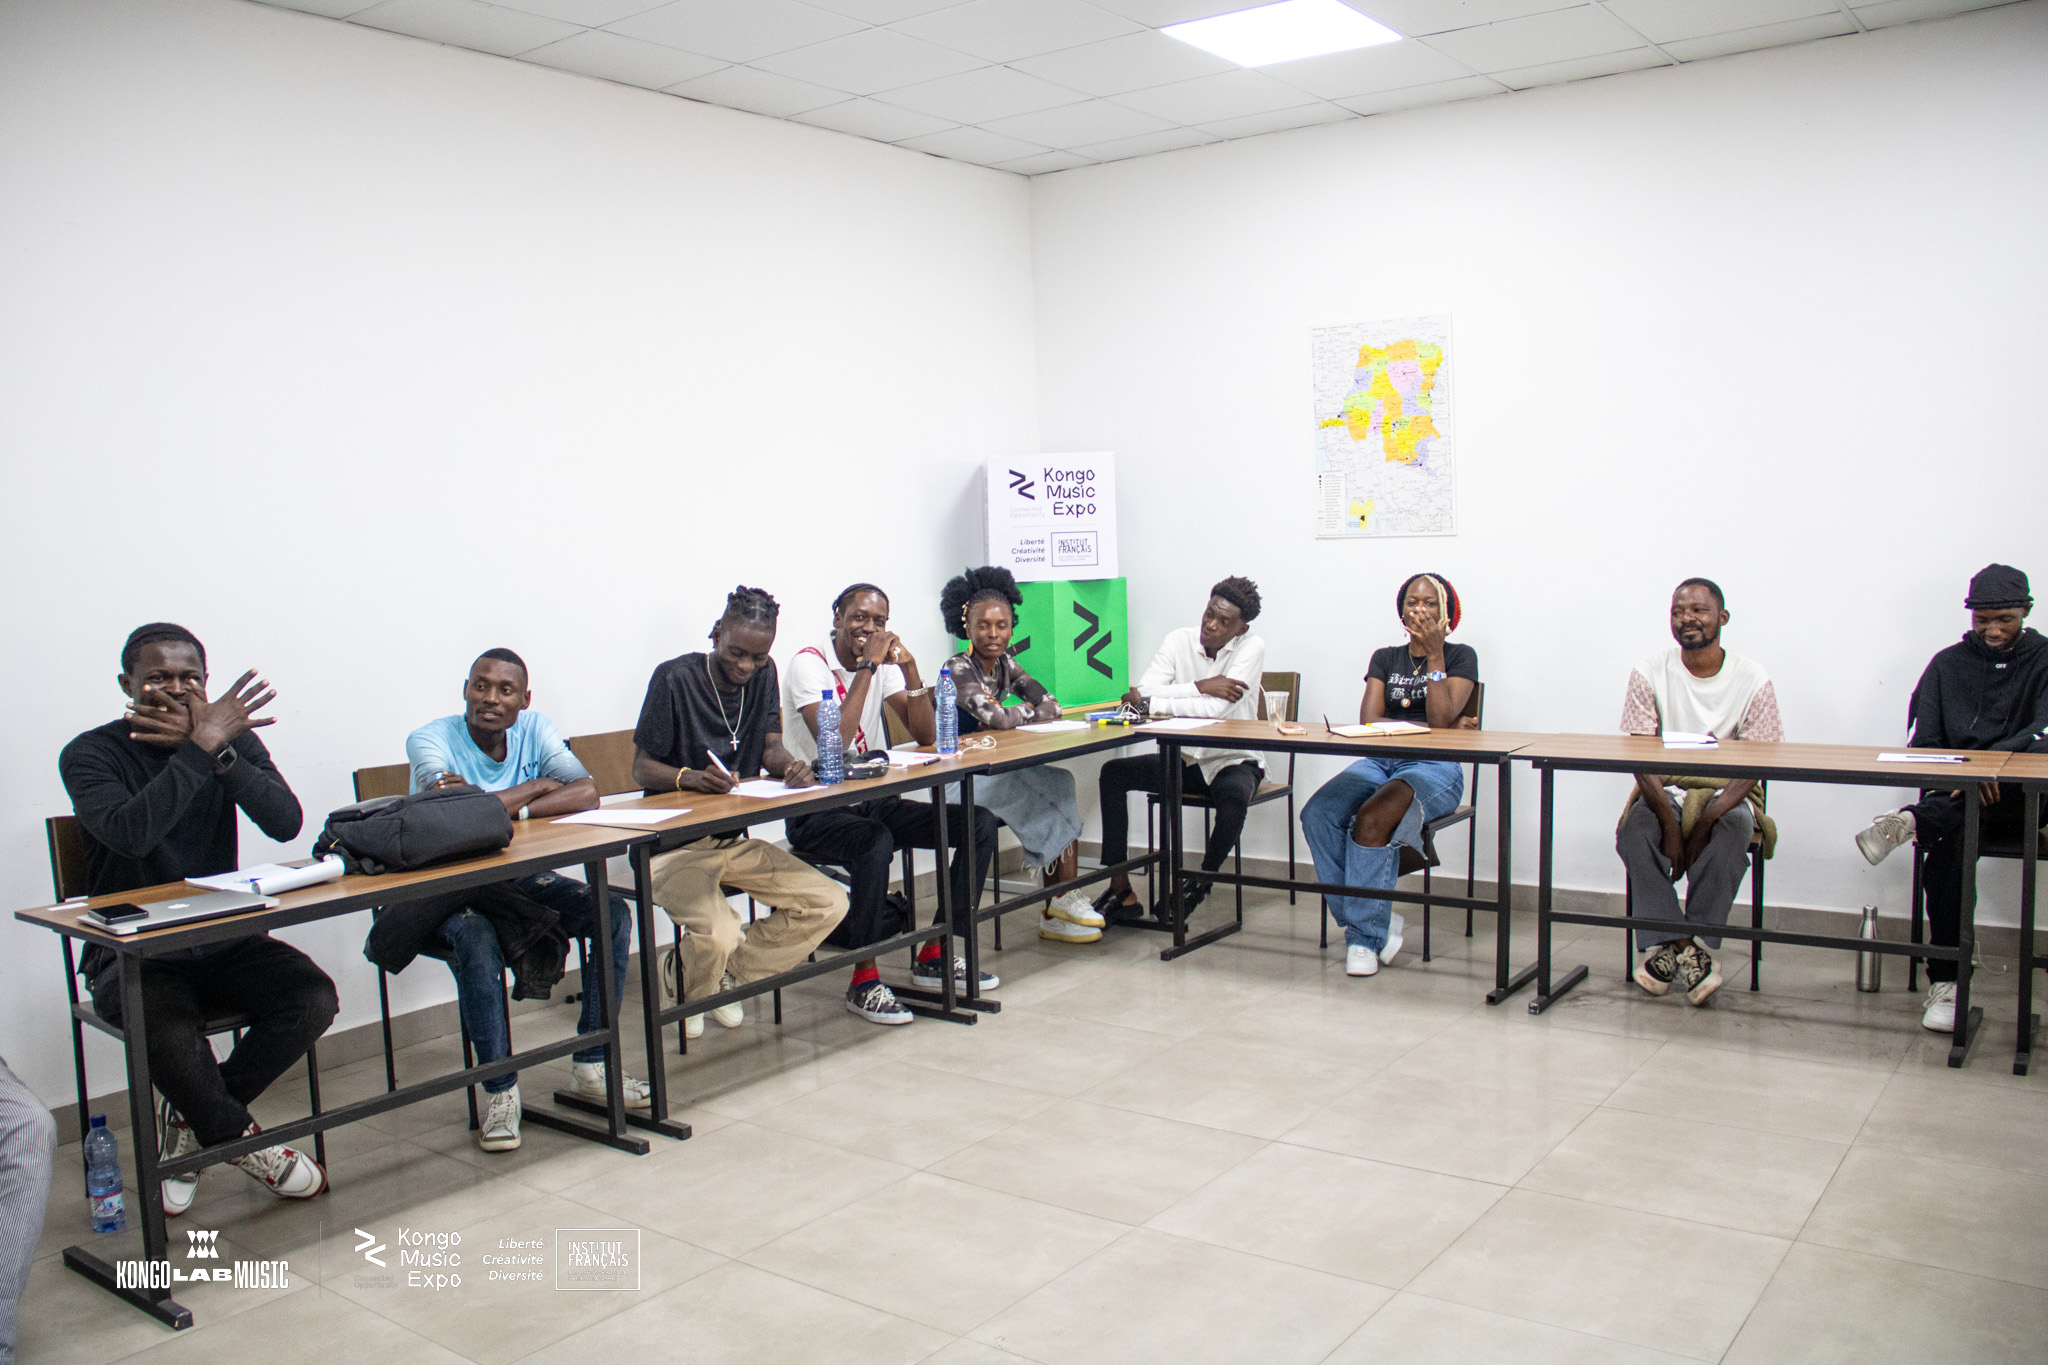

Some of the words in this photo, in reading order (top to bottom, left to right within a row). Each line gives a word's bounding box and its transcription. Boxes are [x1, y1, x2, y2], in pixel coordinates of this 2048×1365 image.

[1044, 467, 1095, 484] Kongo
[1046, 485, 1095, 499] Music
[1053, 501, 1096, 518] Expo
[1020, 538, 1045, 546] Liberté
[1058, 538, 1088, 547] INSTITUT
[1011, 546, 1045, 555] Créativité
[1015, 555, 1046, 563] Diversité
